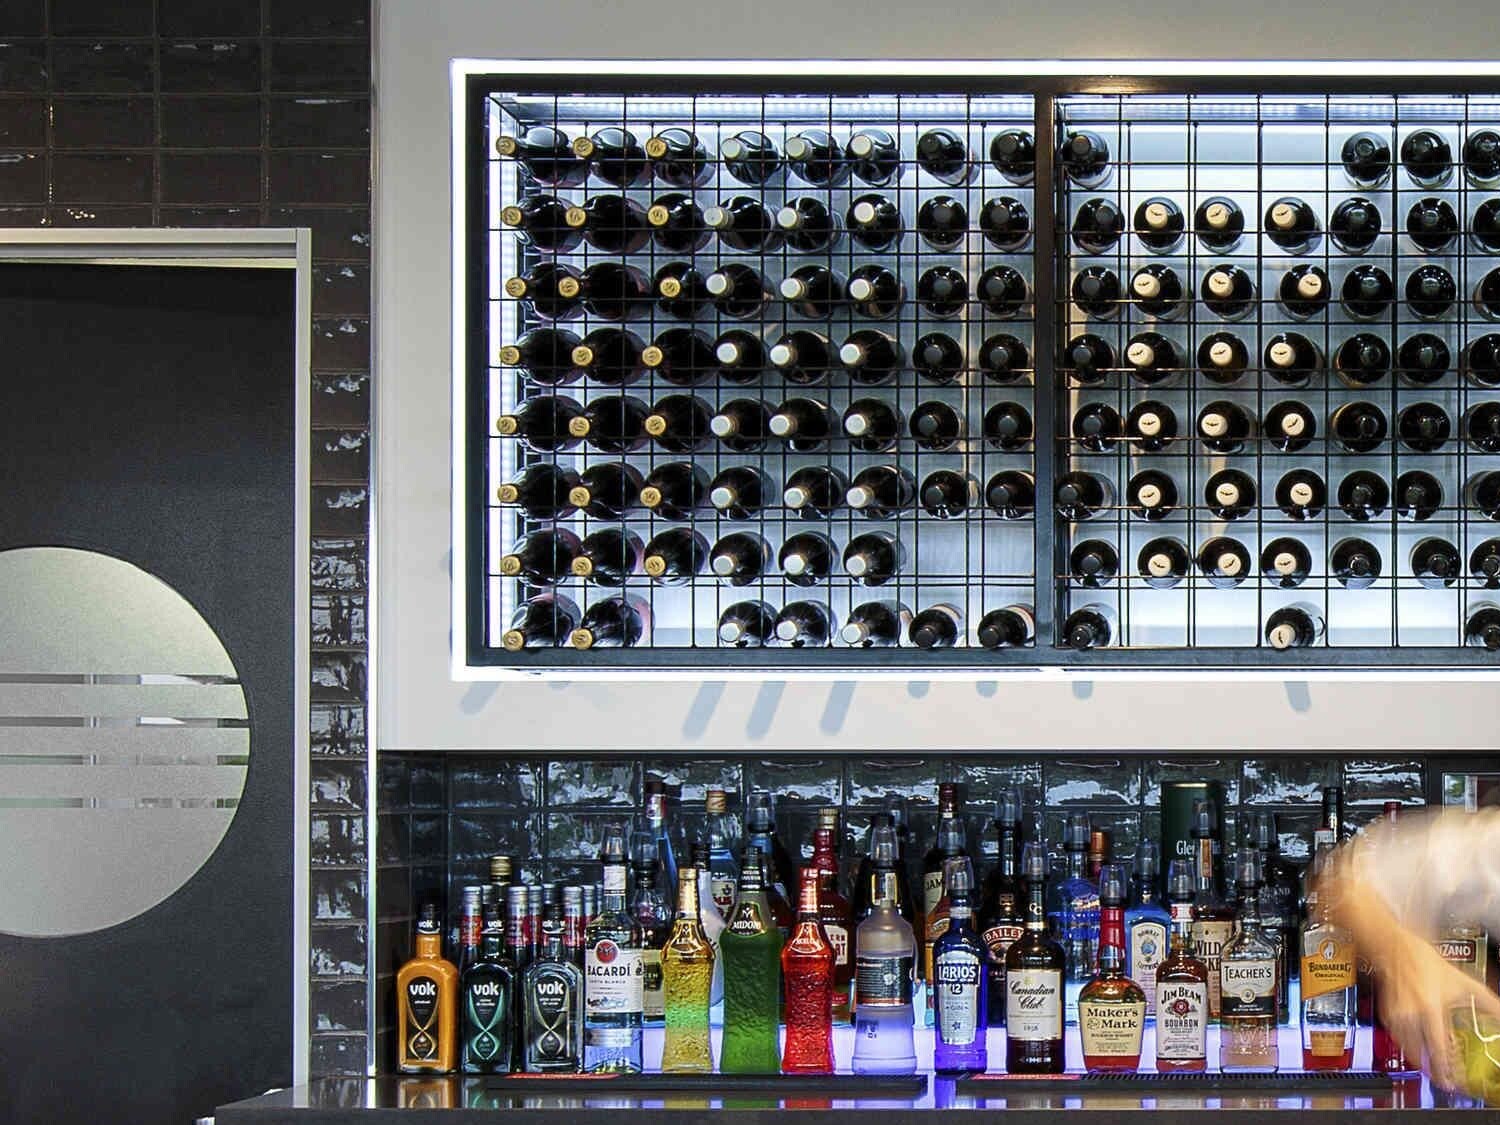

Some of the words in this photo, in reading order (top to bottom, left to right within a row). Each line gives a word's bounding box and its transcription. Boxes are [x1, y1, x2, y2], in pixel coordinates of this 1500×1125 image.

[938, 965, 977, 978] LARIOS
[1224, 966, 1272, 982] TEACHER'S
[1009, 980, 1056, 996] Canadian
[1161, 989, 1177, 1004] JIM
[1178, 986, 1201, 1004] BEAM
[1018, 995, 1046, 1010] Club
[1087, 1008, 1138, 1018] Maker's
[1101, 1019, 1138, 1029] Mark
[1164, 1018, 1199, 1028] BOURBON
